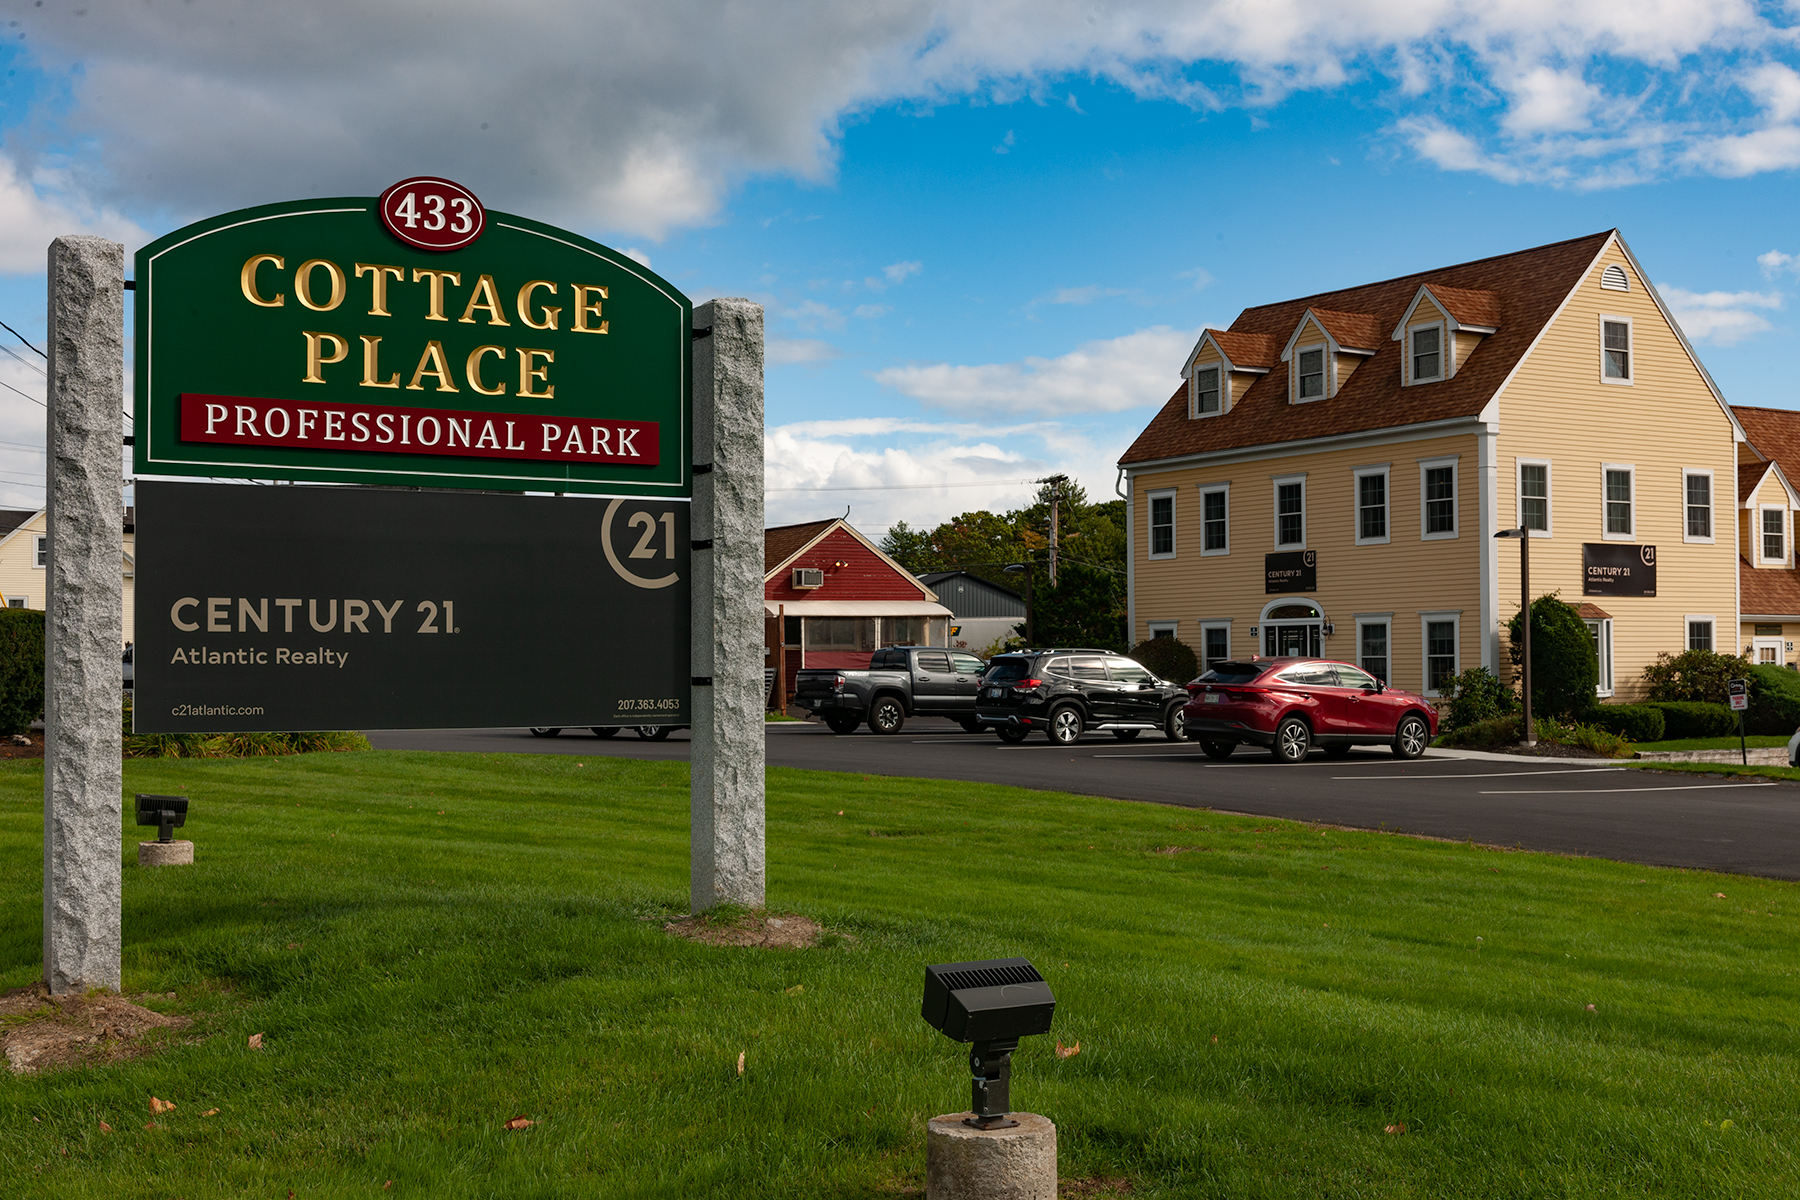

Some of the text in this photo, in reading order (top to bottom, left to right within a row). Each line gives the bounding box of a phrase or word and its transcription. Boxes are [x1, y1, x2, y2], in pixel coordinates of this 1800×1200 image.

[394, 192, 474, 234] 433
[240, 254, 610, 335] COTTAGE
[302, 330, 557, 399] PLACE
[205, 404, 641, 457] PROFESSIONAL PARK
[1268, 570, 1295, 578] CENTURY
[1588, 567, 1622, 576] CENTURY
[170, 597, 404, 633] CENTURY
[171, 646, 349, 669] Atlantic Realty
[171, 703, 264, 716] c21atlantic.com
[617, 698, 680, 711] 207.363.4053
